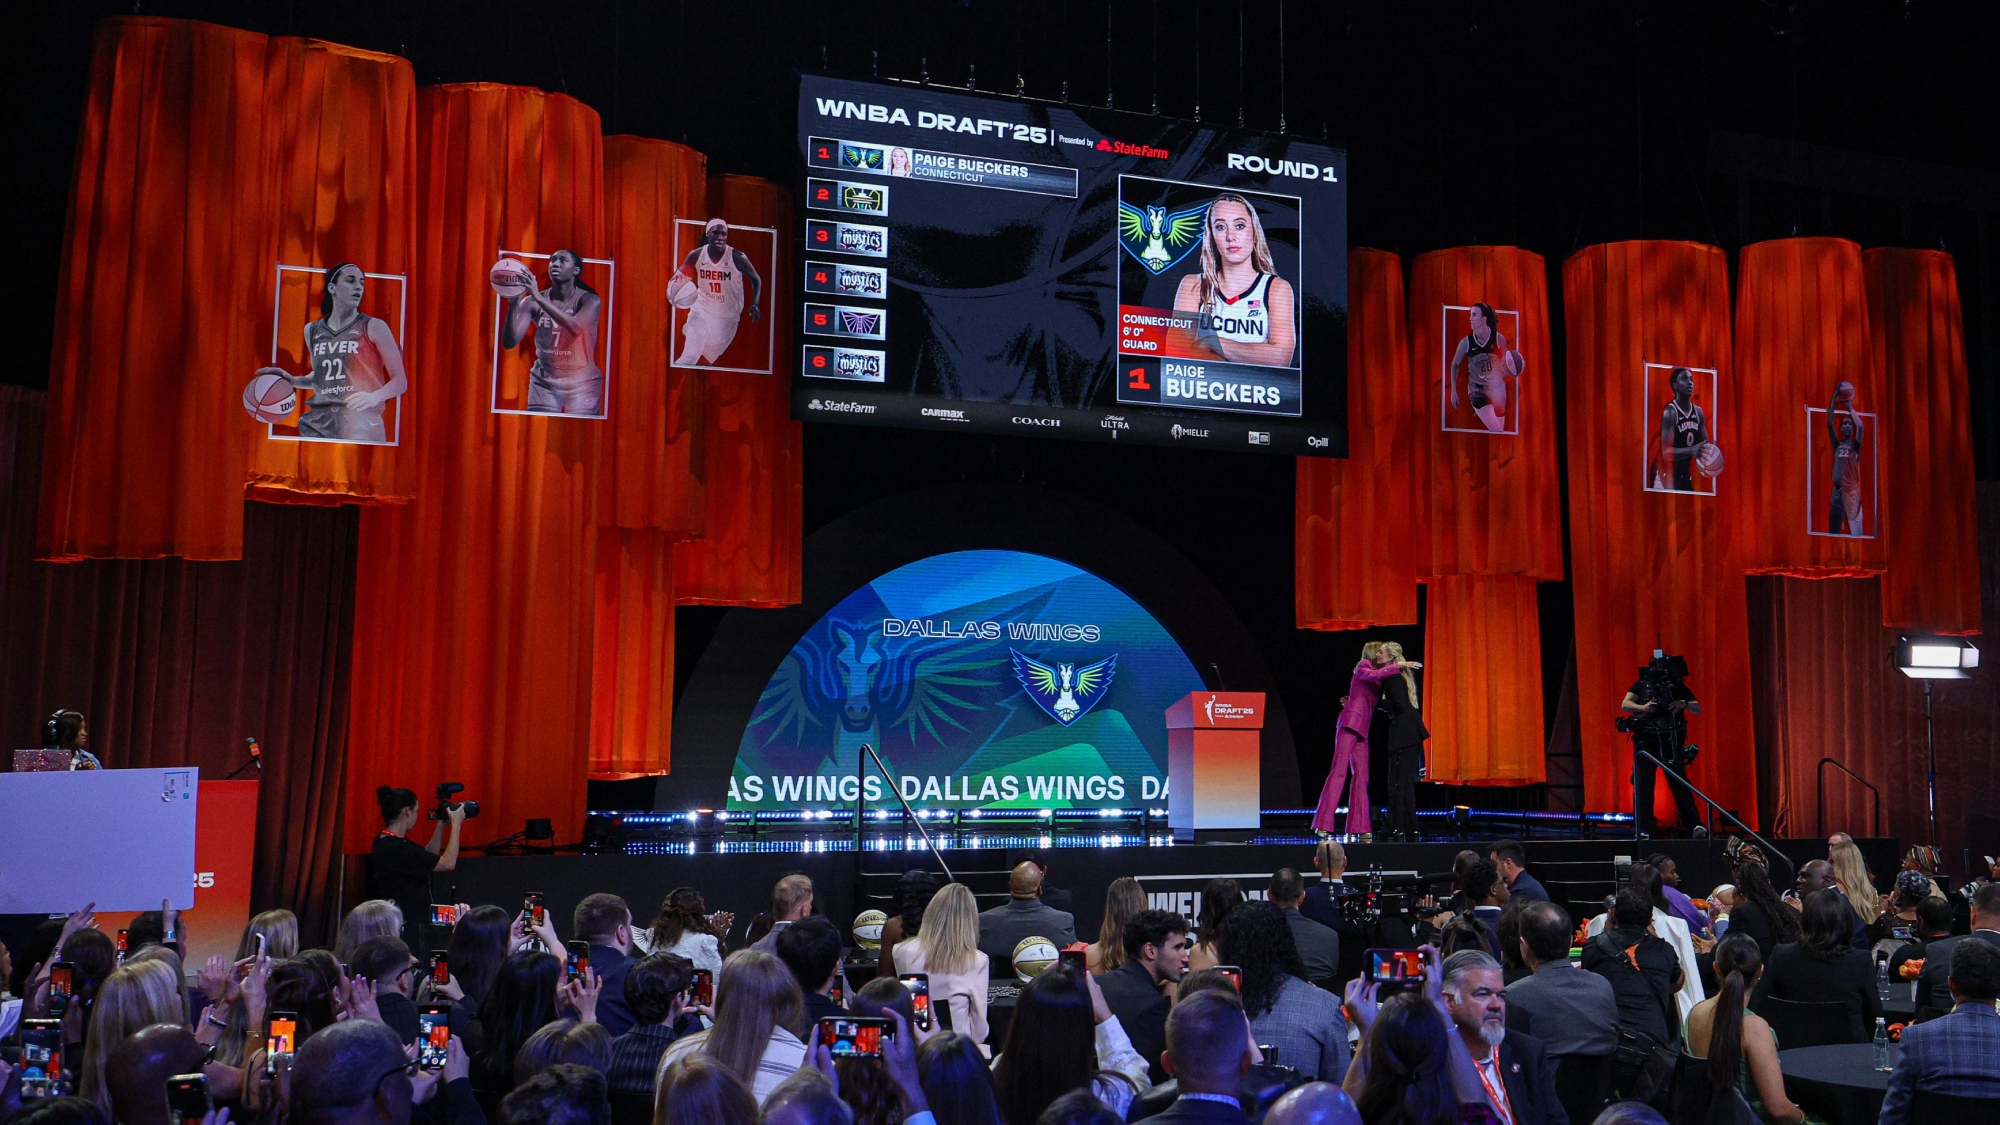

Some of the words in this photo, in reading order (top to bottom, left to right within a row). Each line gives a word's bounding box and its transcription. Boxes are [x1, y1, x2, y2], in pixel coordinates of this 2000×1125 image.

[815, 97, 911, 126] WNBA
[918, 110, 1048, 145] DRAFT'25
[1058, 134, 1086, 146] Presented
[1086, 138, 1094, 149] by
[817, 147, 830, 159] 1
[914, 153, 956, 170] PAIGE
[958, 160, 1029, 178] BUECKERS
[1227, 152, 1320, 180] ROUND
[1322, 165, 1338, 183] 1
[914, 166, 985, 183] CONNECTICUT
[817, 188, 830, 200] 2
[815, 229, 829, 242] 3
[699, 269, 732, 281] DREAM
[814, 271, 828, 284] 4
[709, 282, 722, 294] 10
[813, 313, 827, 326] 5
[1122, 313, 1194, 330] CONNECTICUT
[551, 331, 561, 348] 7
[1122, 339, 1158, 351] GUARD
[313, 340, 359, 356] FEVER
[812, 354, 826, 368] 6
[322, 358, 346, 381] 22
[1165, 363, 1206, 379] PAIGE
[1128, 367, 1151, 390] 1
[320, 384, 355, 396] salesforce
[1166, 378, 1281, 406] BUECKERS
[823, 400, 876, 415] StateFarm
[1011, 416, 1062, 428] COACH
[1100, 420, 1130, 430] ULTRA
[1182, 428, 1210, 438] MIELLE
[1686, 431, 1695, 447] 0
[1307, 435, 1329, 449] Opill
[1838, 449, 1850, 458] 22
[883, 618, 1001, 640] DALLAS
[1008, 622, 1101, 642] WINGS
[771, 775, 882, 802] WINGS
[900, 775, 1019, 801] DALLAS
[1026, 775, 1125, 801] WINGS
